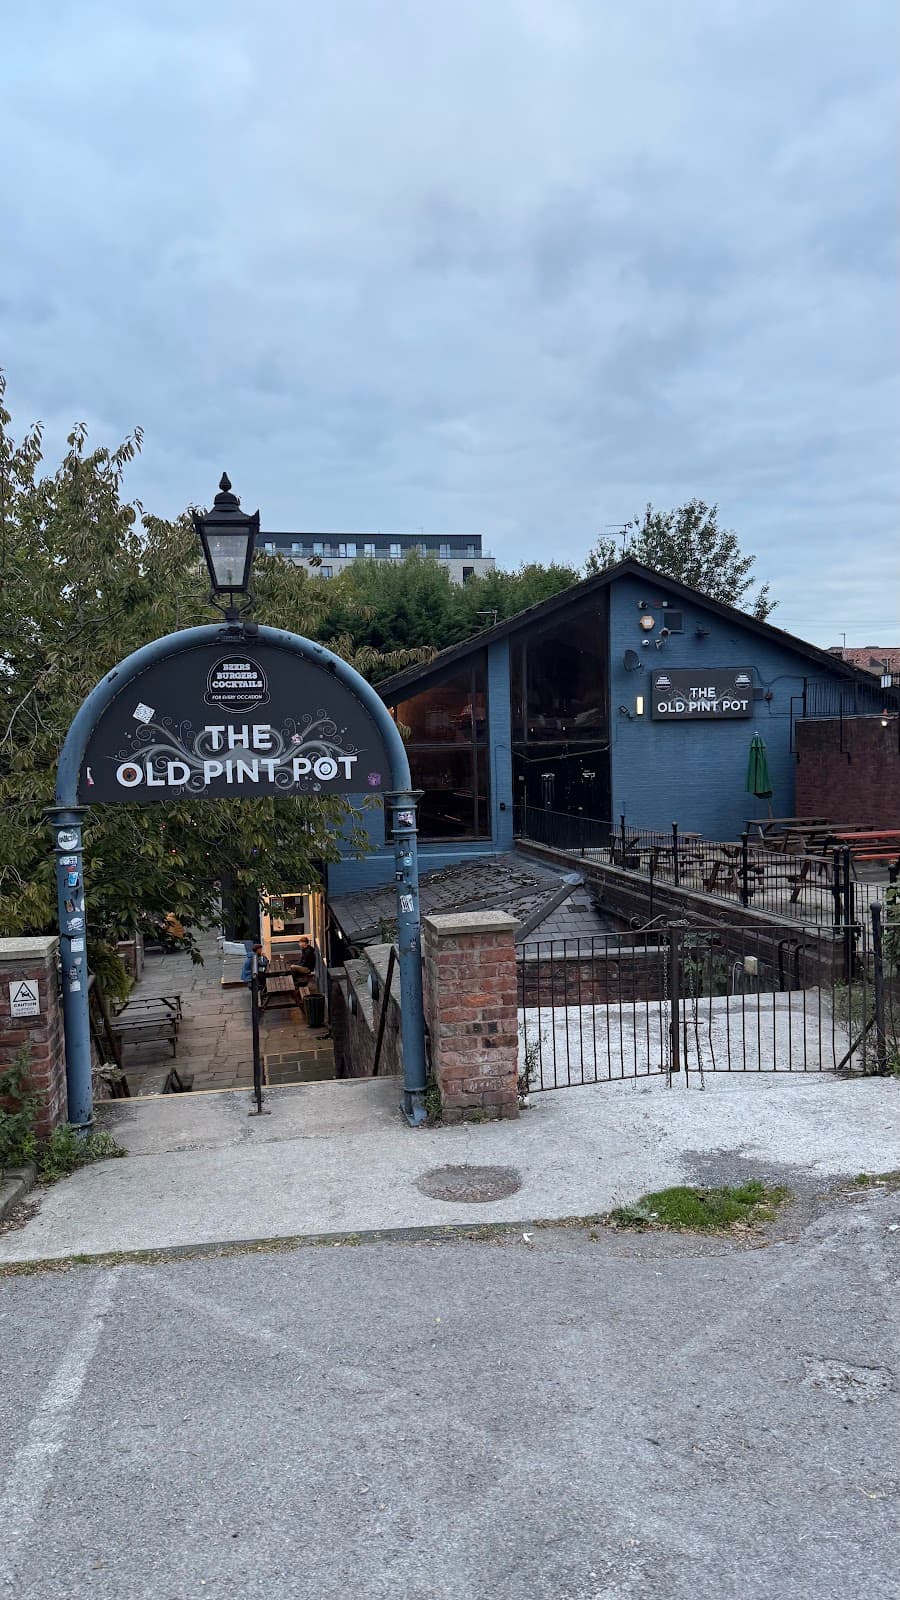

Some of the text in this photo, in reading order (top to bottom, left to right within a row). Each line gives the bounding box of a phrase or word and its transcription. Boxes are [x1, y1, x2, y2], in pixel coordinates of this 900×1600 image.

[216, 672, 258, 680] BURGERS
[690, 687, 716, 698] THE
[657, 700, 749, 713] OLD PINT POT
[204, 724, 273, 750] THE
[116, 756, 358, 788] OLD PINT POT
